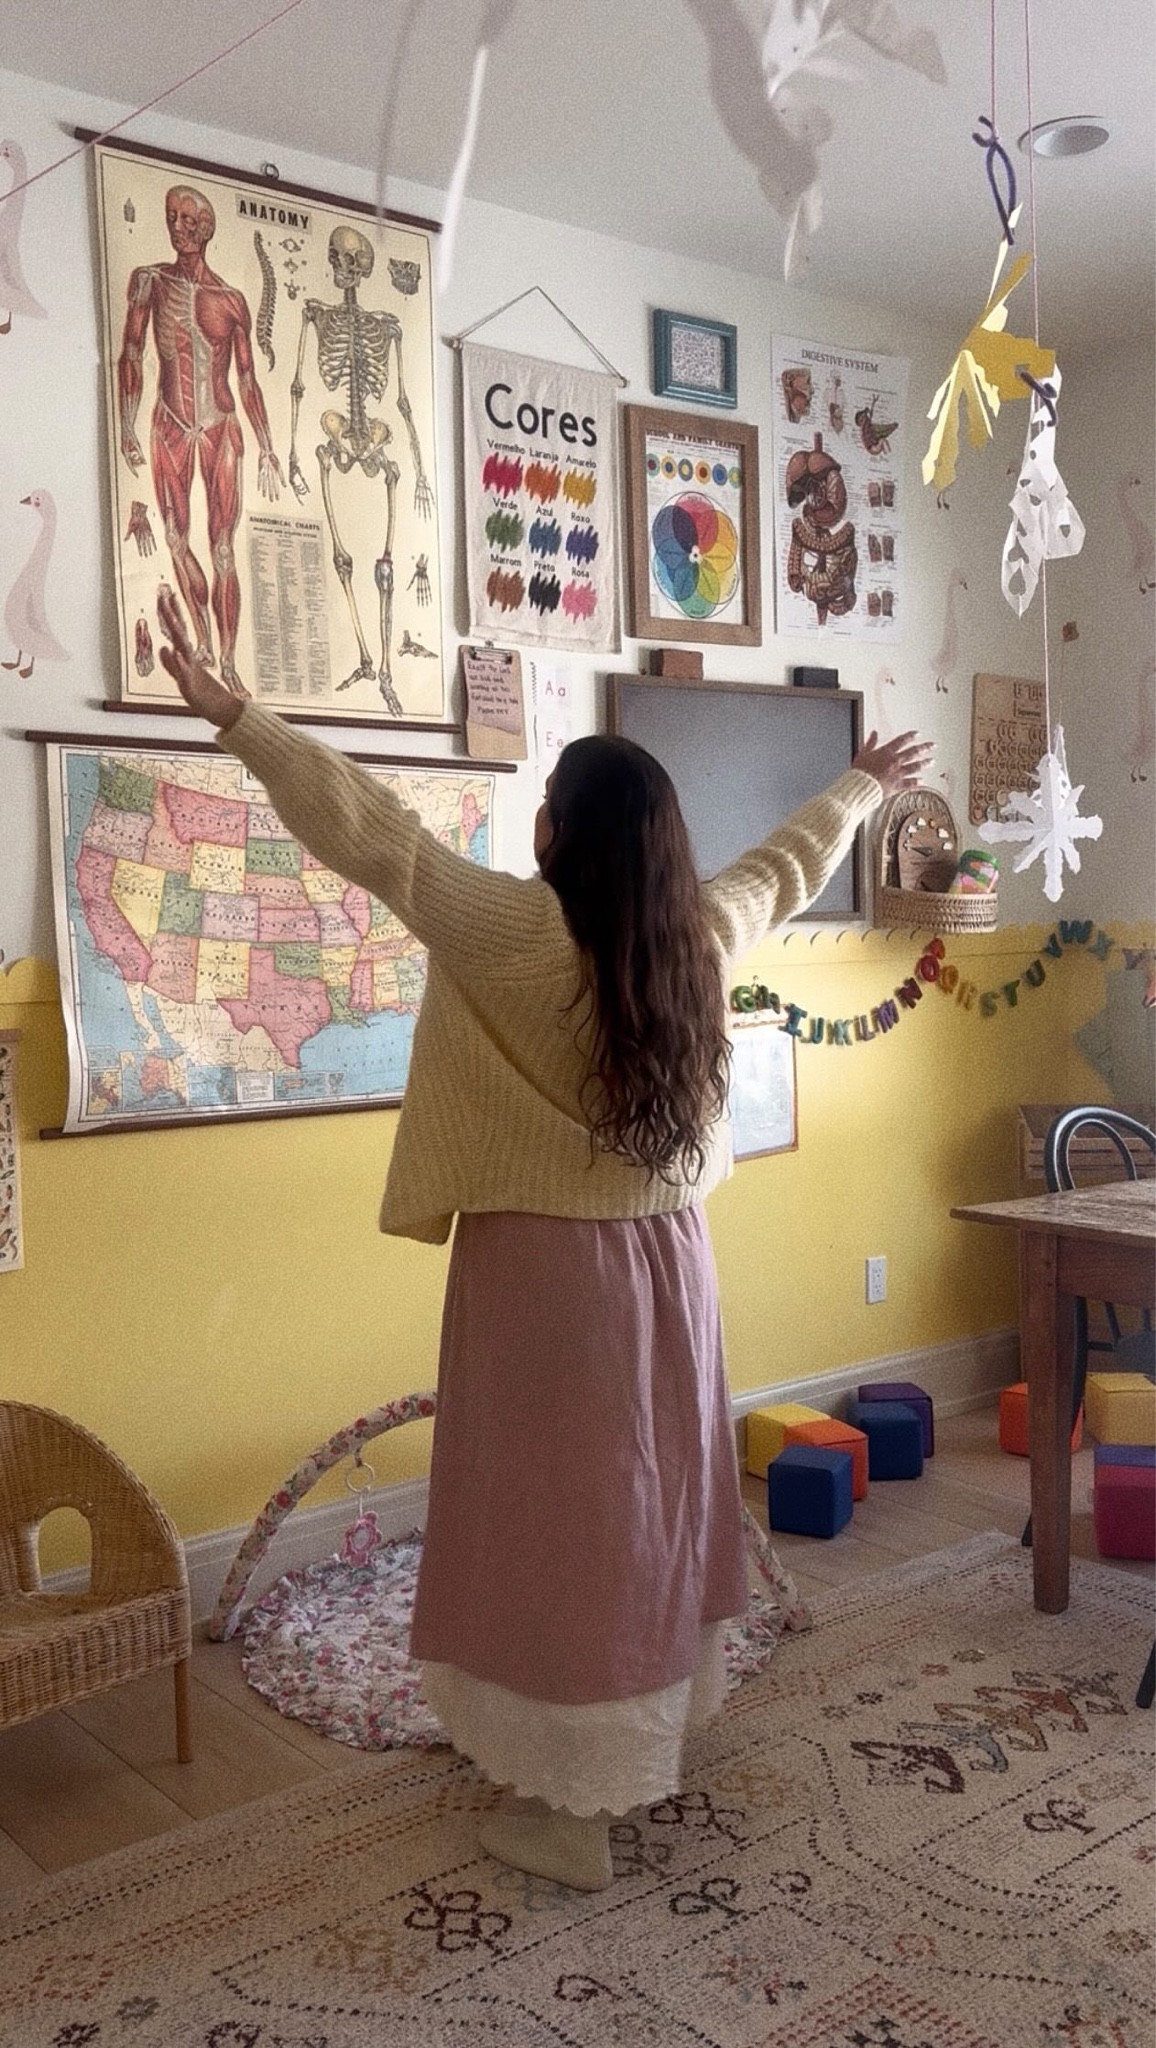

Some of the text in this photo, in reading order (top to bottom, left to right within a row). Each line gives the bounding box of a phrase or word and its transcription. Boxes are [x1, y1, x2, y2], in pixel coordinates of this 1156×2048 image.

[240, 199, 308, 229] ANATOMY
[801, 348, 844, 367] DIGESTIVE
[844, 357, 879, 374] SYSTEM
[484, 383, 597, 448] Cores
[486, 438, 597, 469] Vermelho Laranja Amarelo
[249, 516, 292, 528] ANATOMICAL
[295, 522, 320, 532] CHARTS
[492, 498, 590, 524] Verde Azul Roxo
[490, 554, 590, 579] Marrom Preto Rosa
